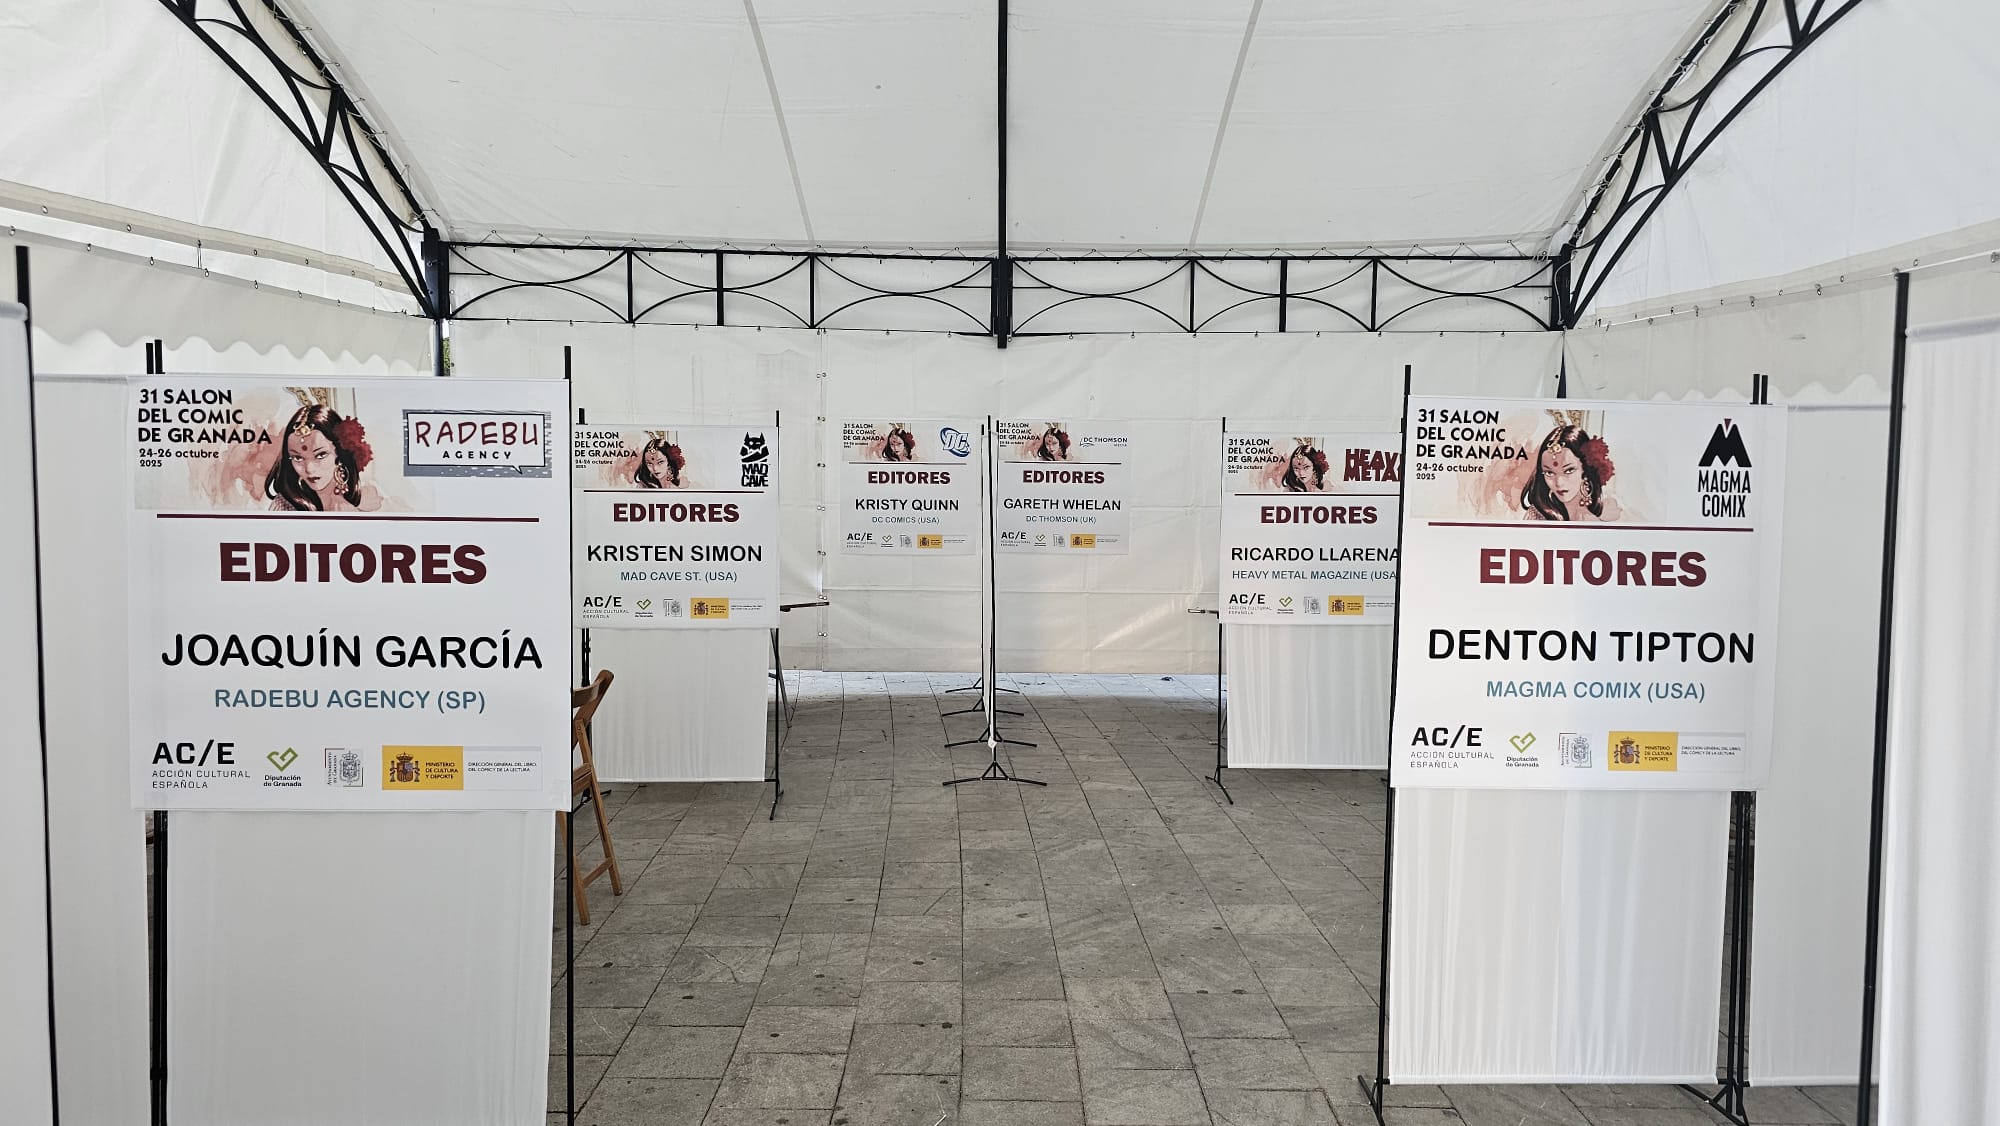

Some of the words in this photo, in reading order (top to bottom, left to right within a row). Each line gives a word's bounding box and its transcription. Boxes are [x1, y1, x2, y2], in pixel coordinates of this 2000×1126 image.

[140, 389, 157, 404] 31
[164, 389, 232, 405] SALON
[138, 408, 172, 424] DEL
[178, 409, 243, 425] COMIC
[1418, 408, 1435, 423] 31
[1440, 410, 1499, 424] SALON
[138, 428, 162, 443] DE
[167, 428, 271, 445] GRANADA
[415, 421, 538, 447] RADEBU
[1417, 426, 1445, 441] DEL
[1451, 427, 1506, 442] COMIC
[139, 448, 171, 459] 24-26
[175, 448, 219, 460] octubre
[443, 450, 512, 460] AGENCY
[1416, 444, 1435, 458] DE
[1441, 444, 1528, 461] GRANADA
[140, 460, 162, 468] 2025
[742, 464, 768, 475] MAD
[1416, 463, 1444, 472] 24-26
[1447, 464, 1483, 473] octubre
[742, 474, 768, 487] CAVE
[868, 471, 950, 484] EDITORES
[1023, 470, 1105, 484] EDITORES
[1698, 470, 1751, 493] MAGMA
[856, 499, 907, 510] KRISTY
[912, 500, 959, 511] QUINN
[1004, 498, 1058, 510] GARETH
[1063, 499, 1120, 511] WHELAN
[1702, 494, 1746, 518] COMIX
[614, 503, 739, 523] EDITORES
[885, 516, 916, 524] COMICS
[918, 516, 939, 524] (USA)
[1080, 516, 1096, 524] (UK)
[1261, 506, 1377, 524] EDITORES
[847, 532, 872, 542] AC/E
[1001, 531, 1026, 540] AC/E
[587, 545, 683, 562] KRISTEN
[691, 545, 762, 562] SIMON
[1232, 547, 1313, 561] RICARDO
[1319, 548, 1399, 562] LLARENA
[220, 542, 487, 584] EDITORES
[1480, 548, 1707, 587] EDITORES
[621, 571, 647, 581] MAD
[650, 571, 681, 581] CAVE
[685, 571, 701, 581] ST.
[705, 571, 737, 583] (USA)
[1233, 571, 1269, 580] HEAVY
[1272, 571, 1305, 580] METAL
[1311, 571, 1367, 580] MAGAZINE
[1370, 571, 1397, 581] (USA
[584, 595, 622, 608] AC/E
[1229, 593, 1265, 605] AC/E
[162, 628, 360, 669] JOAQUÍN
[376, 630, 542, 669] GARCÍA
[1429, 628, 1596, 661] DENTON
[1610, 631, 1754, 664] TIPTON
[1486, 680, 1567, 699] MAGMA
[1573, 681, 1641, 700] COMIX
[1648, 682, 1705, 703] (USA)
[215, 689, 318, 709] RADEBU
[327, 690, 430, 709] AGENCY
[438, 690, 485, 713] (SP)
[1411, 724, 1482, 748] AC/E
[152, 739, 234, 766] AC/E
[1448, 751, 1494, 759] CULTURAL
[1411, 760, 1458, 768] ESPAÑOLA
[152, 769, 191, 778] ACCIÓN
[197, 770, 250, 778] CULTURAL
[153, 780, 208, 788] ESPAÑOLA
